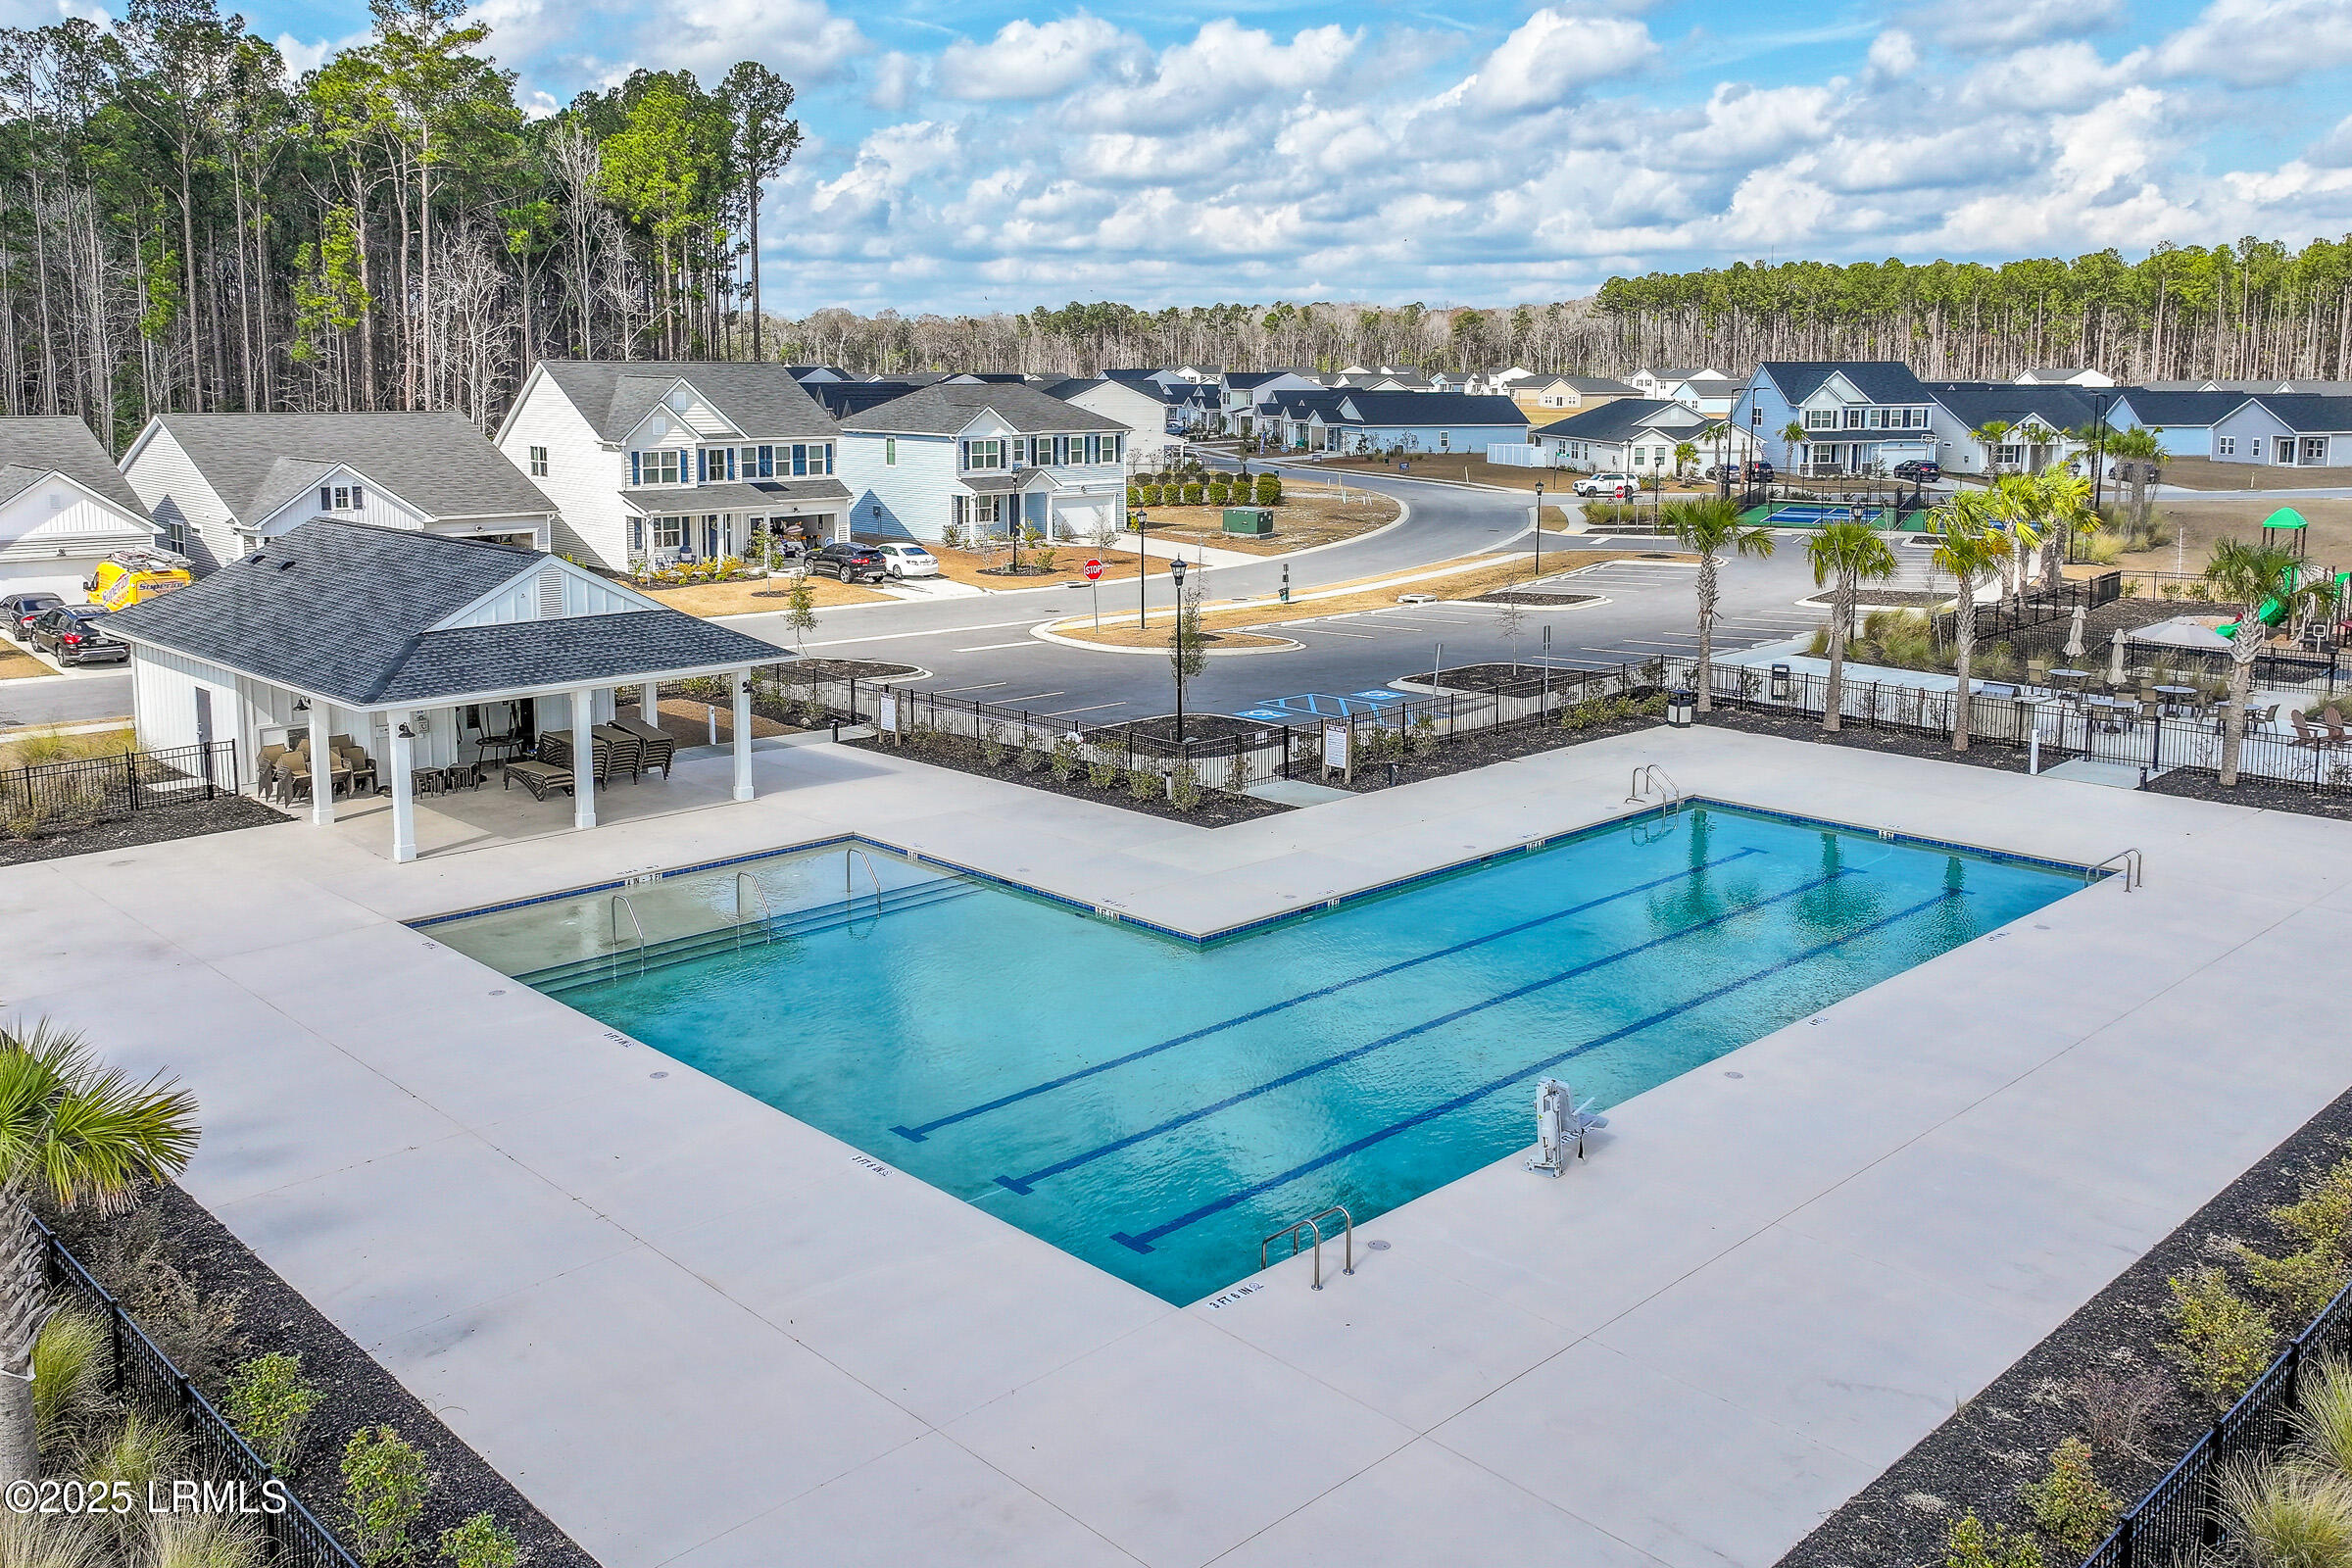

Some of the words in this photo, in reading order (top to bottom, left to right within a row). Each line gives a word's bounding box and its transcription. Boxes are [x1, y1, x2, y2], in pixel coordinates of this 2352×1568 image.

[1086, 565, 1102, 574] STOP
[139, 581, 183, 591] Superior
[1216, 1296, 1232, 1304] FT
